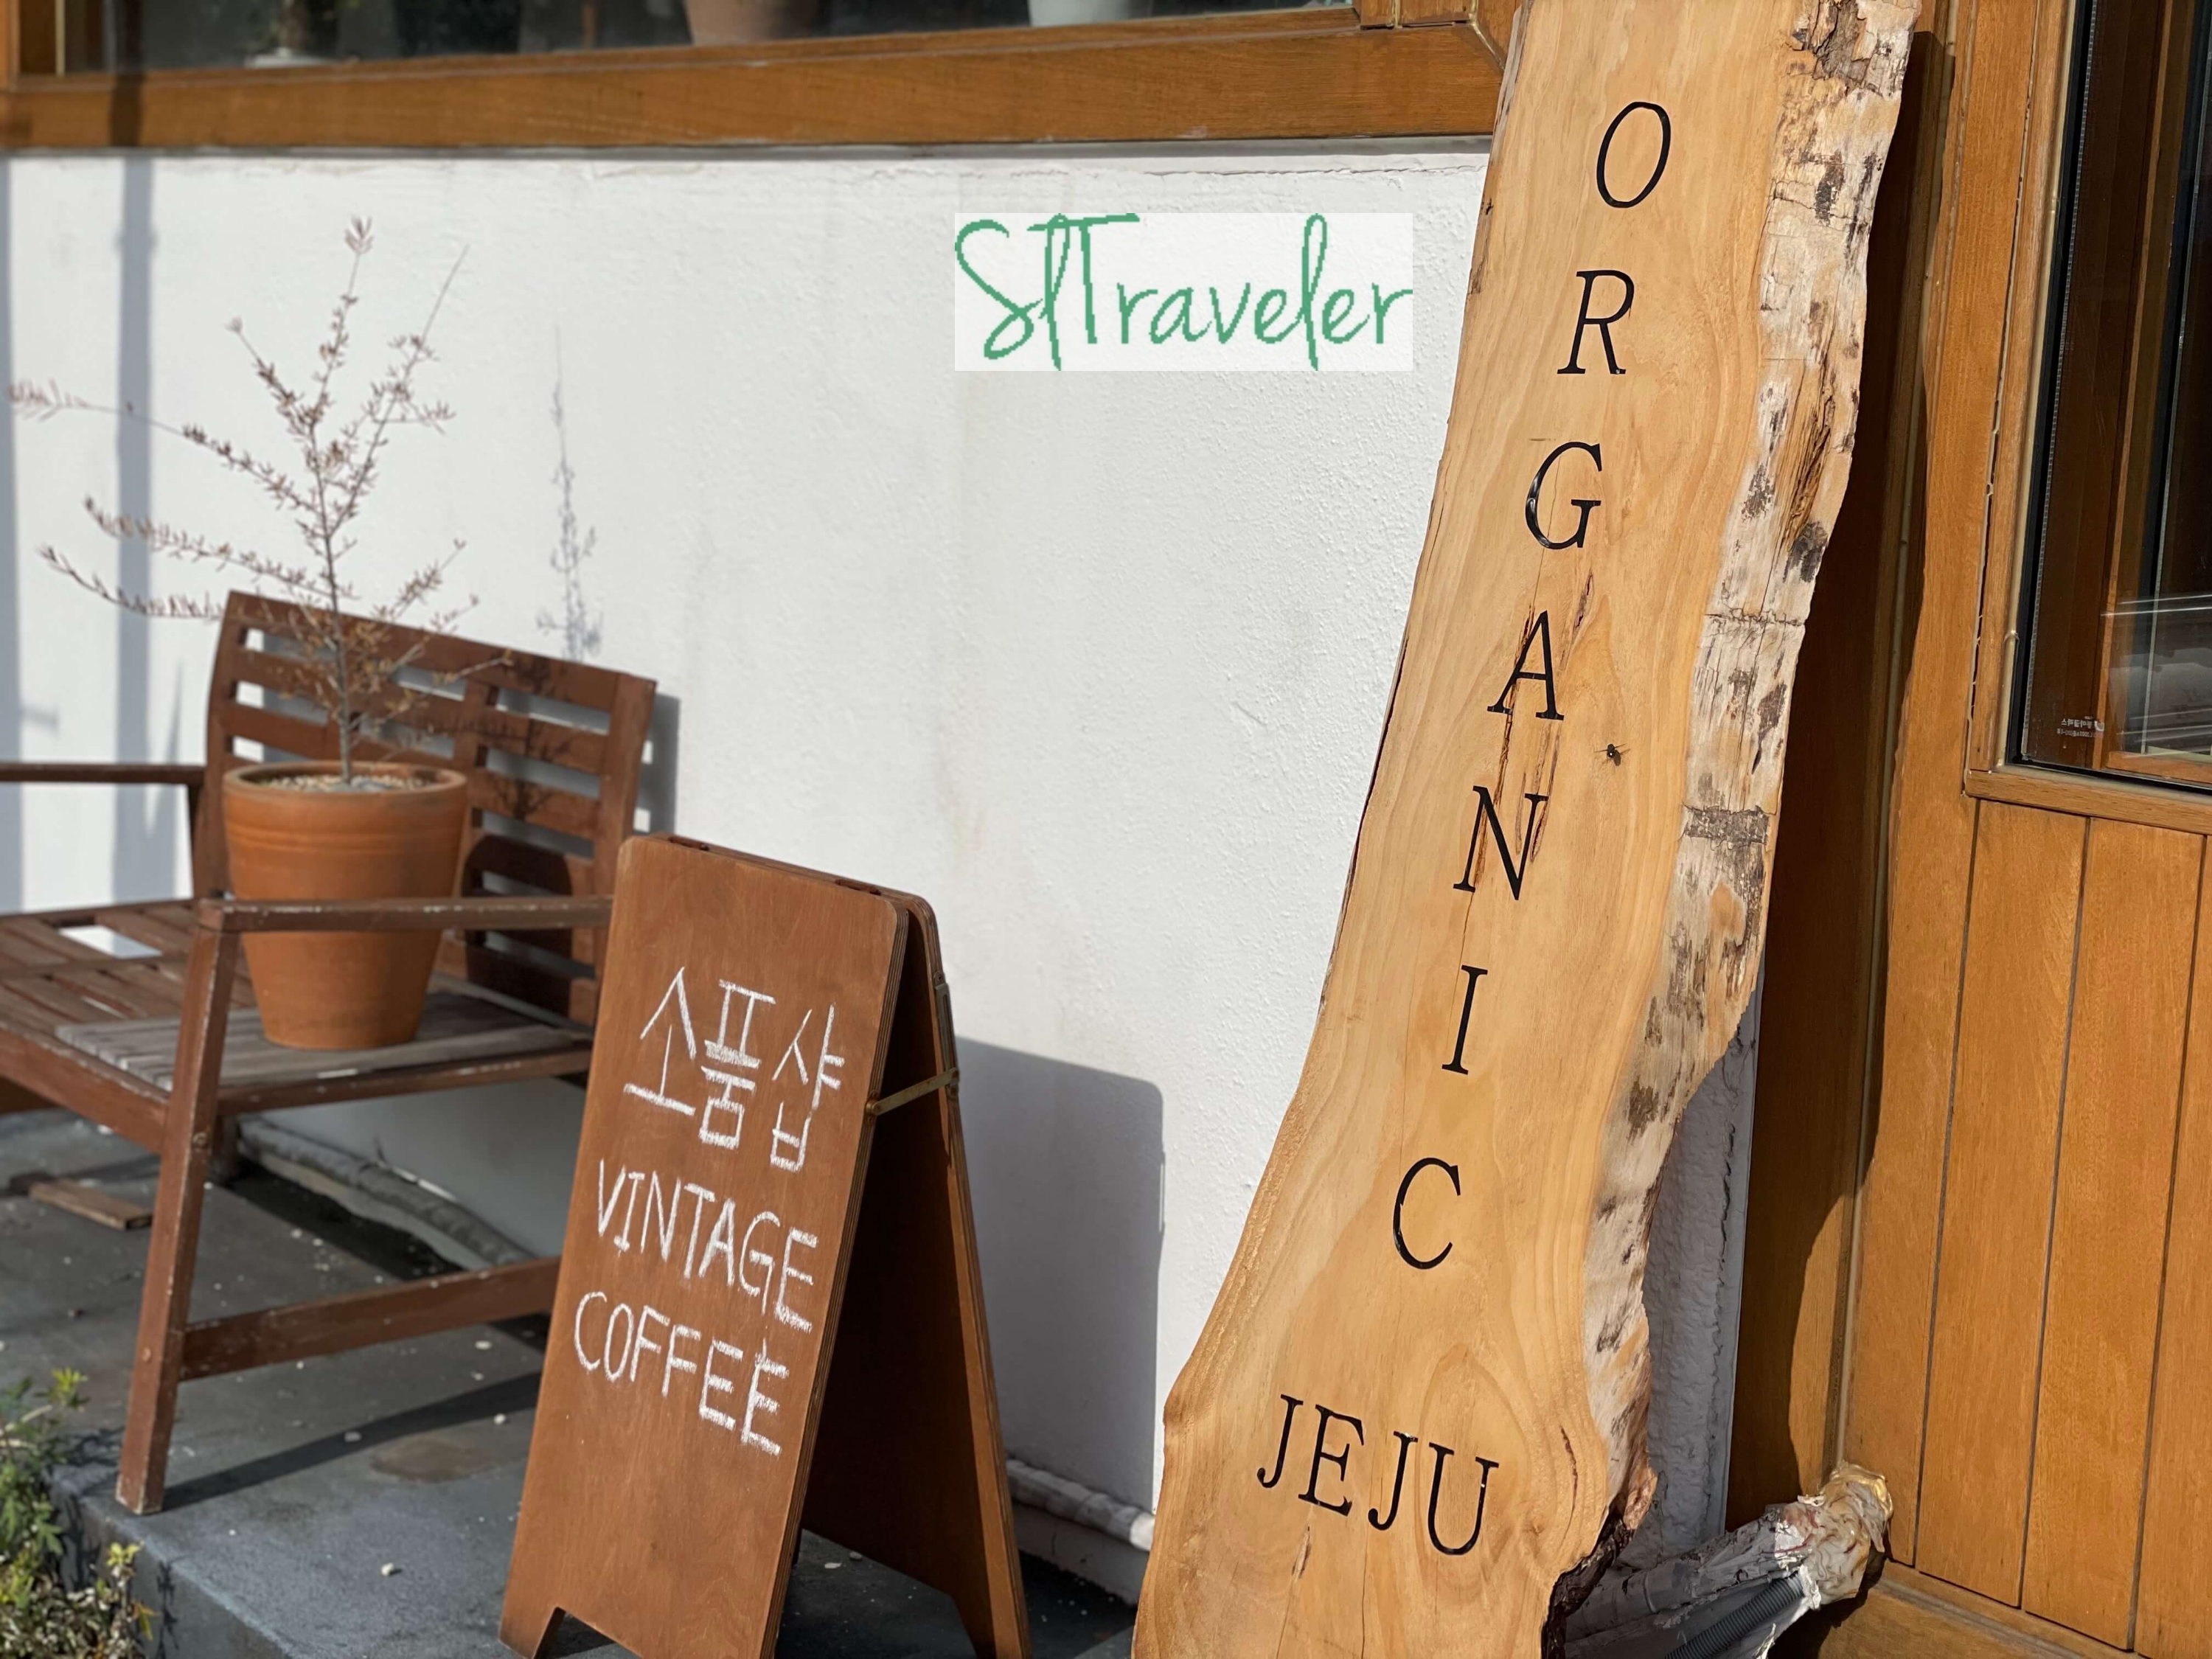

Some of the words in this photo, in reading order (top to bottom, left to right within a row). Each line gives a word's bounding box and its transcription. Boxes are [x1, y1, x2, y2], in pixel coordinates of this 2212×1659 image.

[1393, 101, 1672, 1270] ORGANIC
[623, 966, 846, 1173] 소품샵
[597, 1158, 819, 1335] VINTAGE
[574, 1290, 790, 1460] COFFEE
[1256, 1394, 1500, 1556] JEJU
